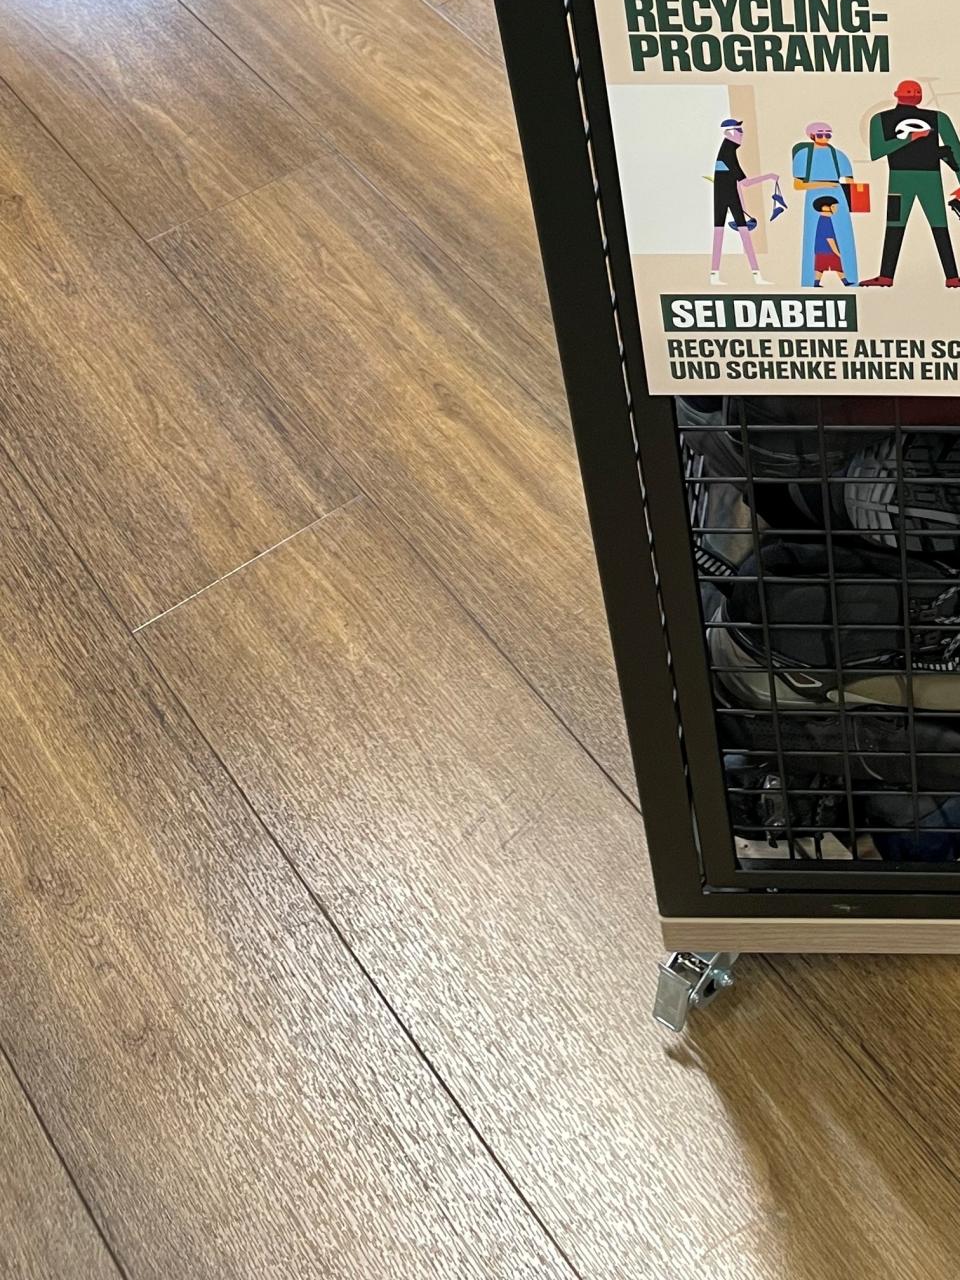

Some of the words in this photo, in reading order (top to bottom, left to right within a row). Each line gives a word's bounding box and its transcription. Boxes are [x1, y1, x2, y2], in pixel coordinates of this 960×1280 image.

[628, 34, 890, 73] PROGRAMM
[671, 300, 727, 328] SEI
[733, 300, 848, 328] DABEI!
[667, 338, 773, 358] RECYCLE
[778, 338, 848, 358] DEINE
[854, 339, 925, 359] ALTEN
[670, 361, 721, 380] UND
[726, 361, 837, 380] SCHENKE
[842, 361, 914, 380] IHNEN
[920, 362, 958, 381] EIN
